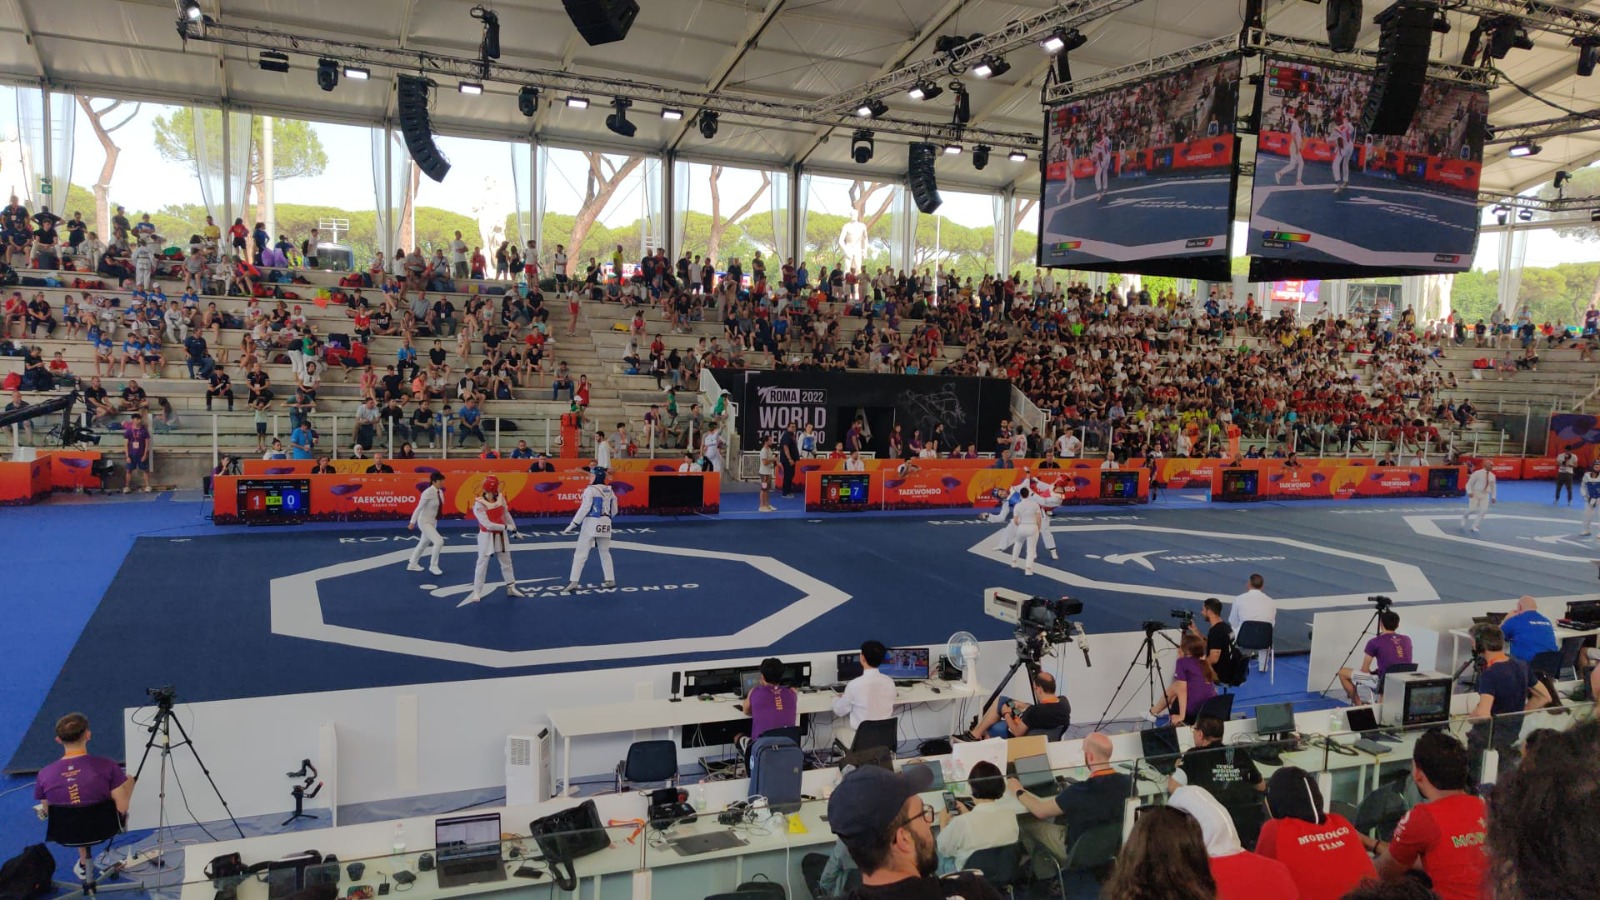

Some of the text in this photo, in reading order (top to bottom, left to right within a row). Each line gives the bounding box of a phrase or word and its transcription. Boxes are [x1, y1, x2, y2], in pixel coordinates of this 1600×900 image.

[770, 390, 824, 403] ROMA 2022
[759, 406, 827, 429] WORLD
[757, 430, 826, 444] TAEKODO
[830, 487, 837, 497] 9
[853, 486, 860, 496] 7
[898, 488, 942, 496] TAEKWONDO
[1125, 483, 1131, 491] 7
[253, 495, 260, 506] 1
[287, 494, 295, 505] 0
[352, 495, 416, 504] TAEKWONDO
[596, 524, 611, 533] GER
[520, 583, 612, 592] WOL
[525, 583, 700, 598] TAEKWONDO
[1297, 826, 1350, 846] MOROCCO
[1318, 839, 1345, 853] TEAM
